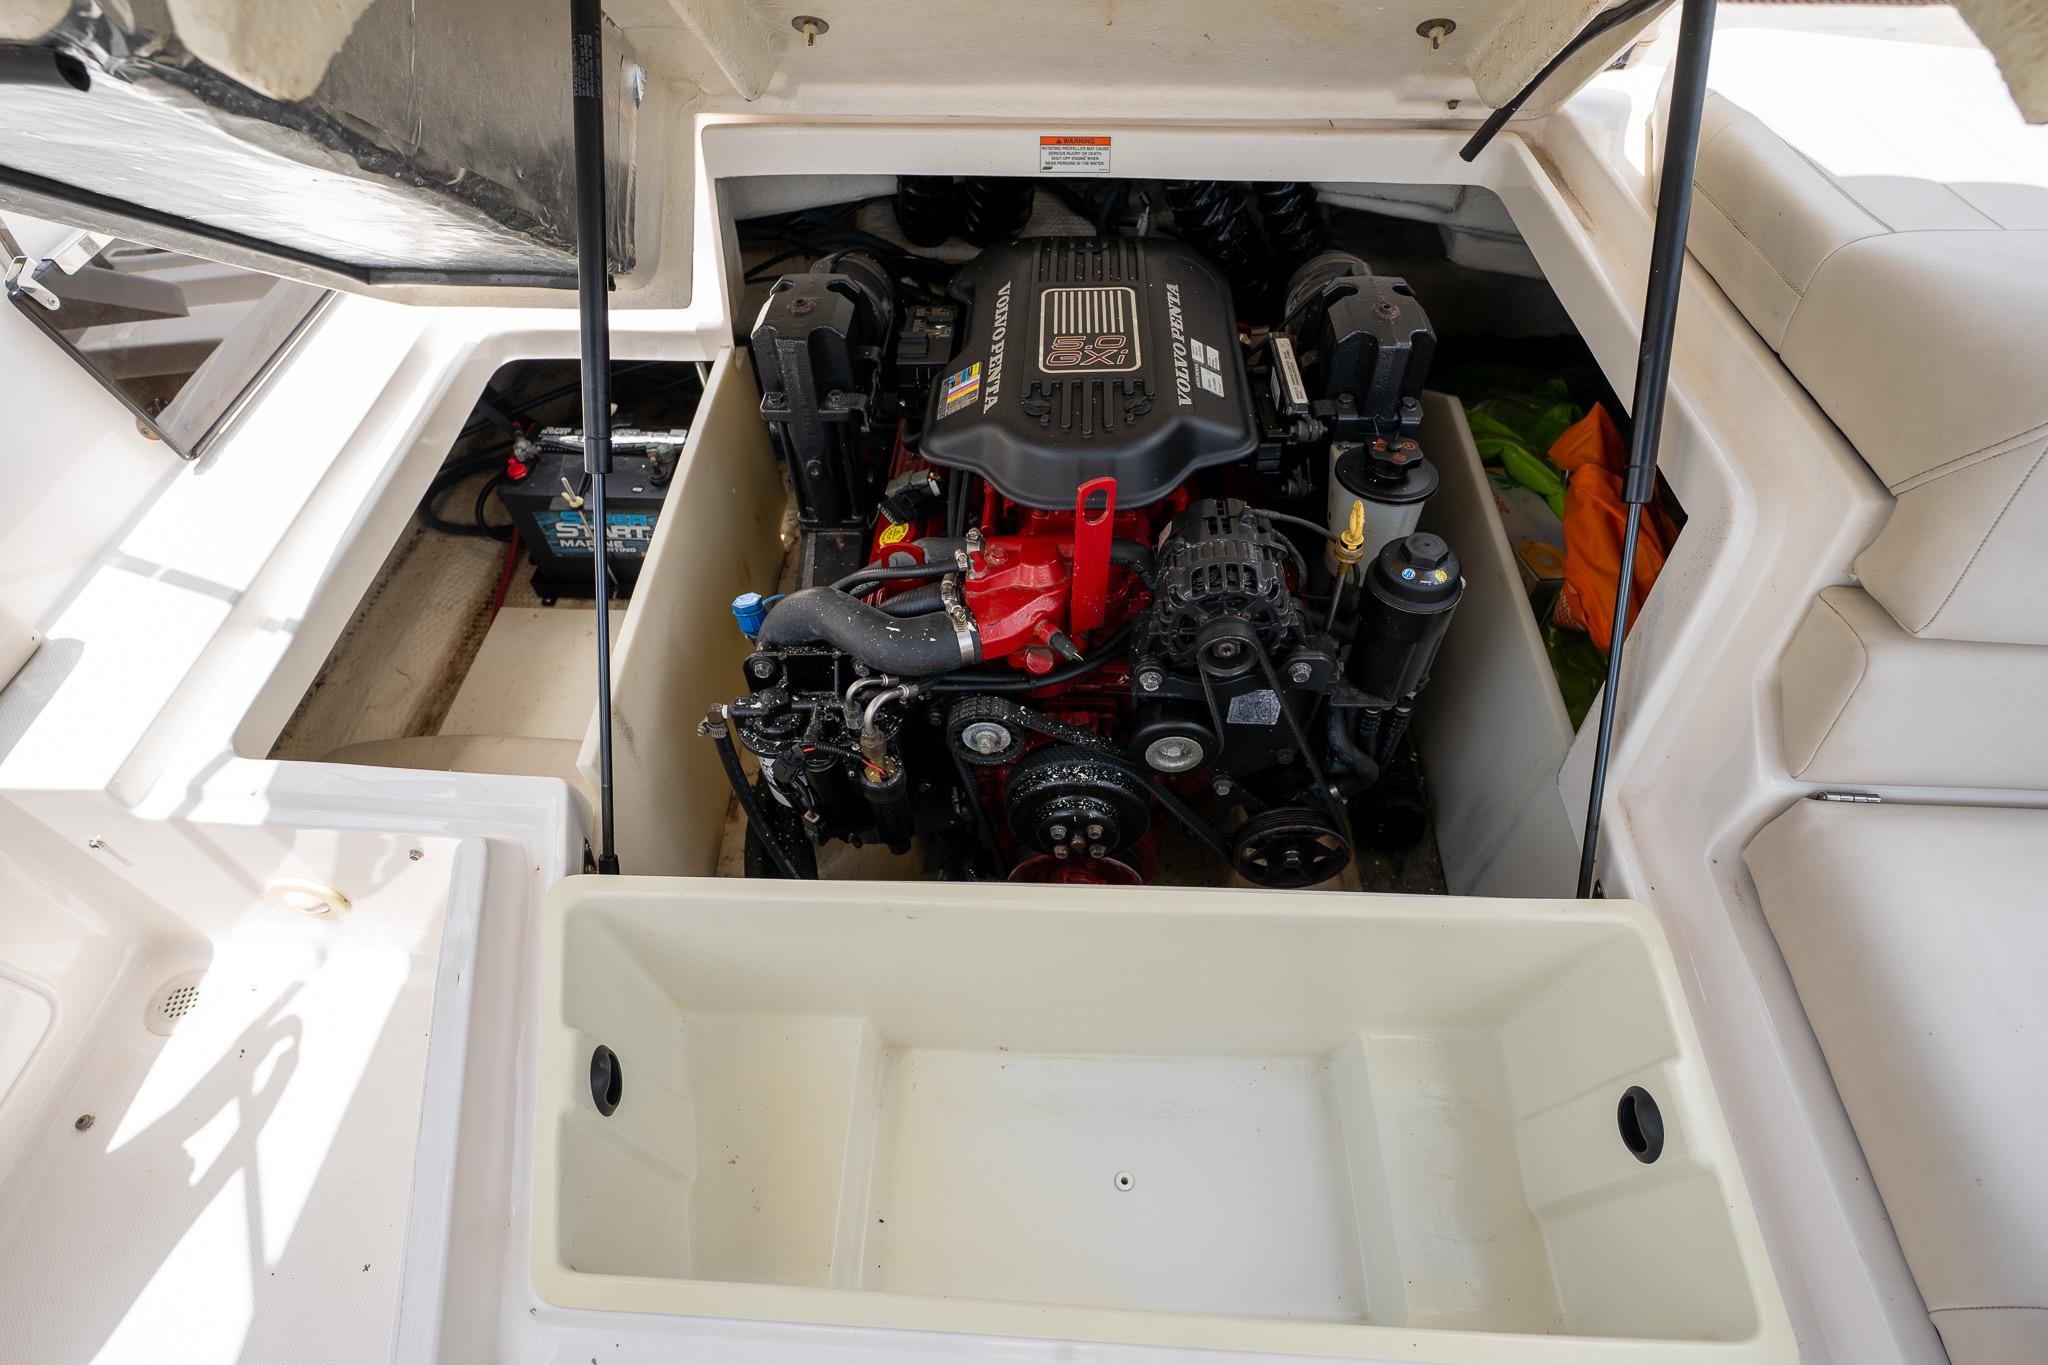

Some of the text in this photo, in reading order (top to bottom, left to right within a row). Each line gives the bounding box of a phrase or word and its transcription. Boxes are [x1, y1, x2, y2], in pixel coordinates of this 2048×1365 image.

[983, 280, 1011, 415] VOLVO PENTA
[1051, 335, 1127, 350] 5.0
[1166, 283, 1193, 406] VOLVO PENTA
[1046, 349, 1129, 366] GXi
[560, 511, 647, 526] SER
[559, 539, 624, 548] MARNE
